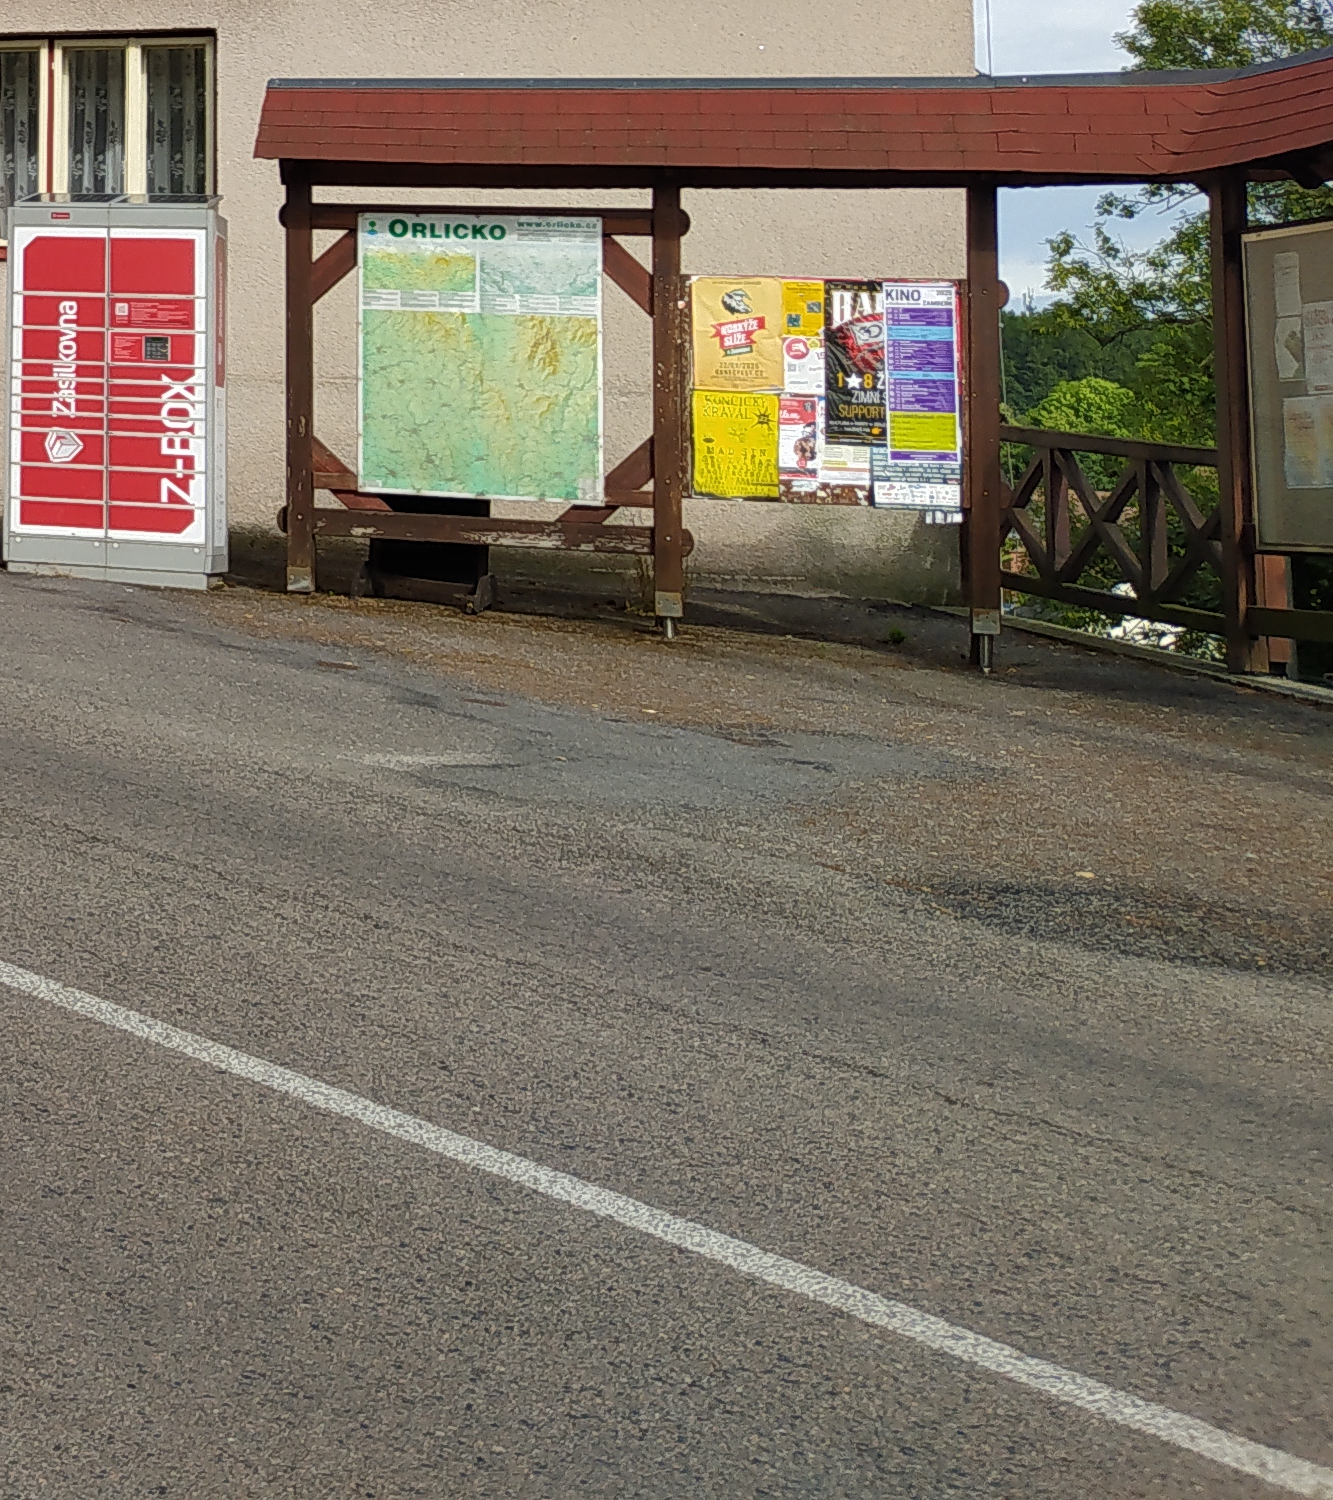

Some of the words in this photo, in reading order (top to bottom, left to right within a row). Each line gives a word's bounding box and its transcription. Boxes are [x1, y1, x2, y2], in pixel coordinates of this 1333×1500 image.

[388, 219, 507, 240] ORLICKO
[885, 288, 921, 301] KINO
[52, 300, 78, 418] Zásilkovna
[160, 373, 196, 504] Z-BOX
